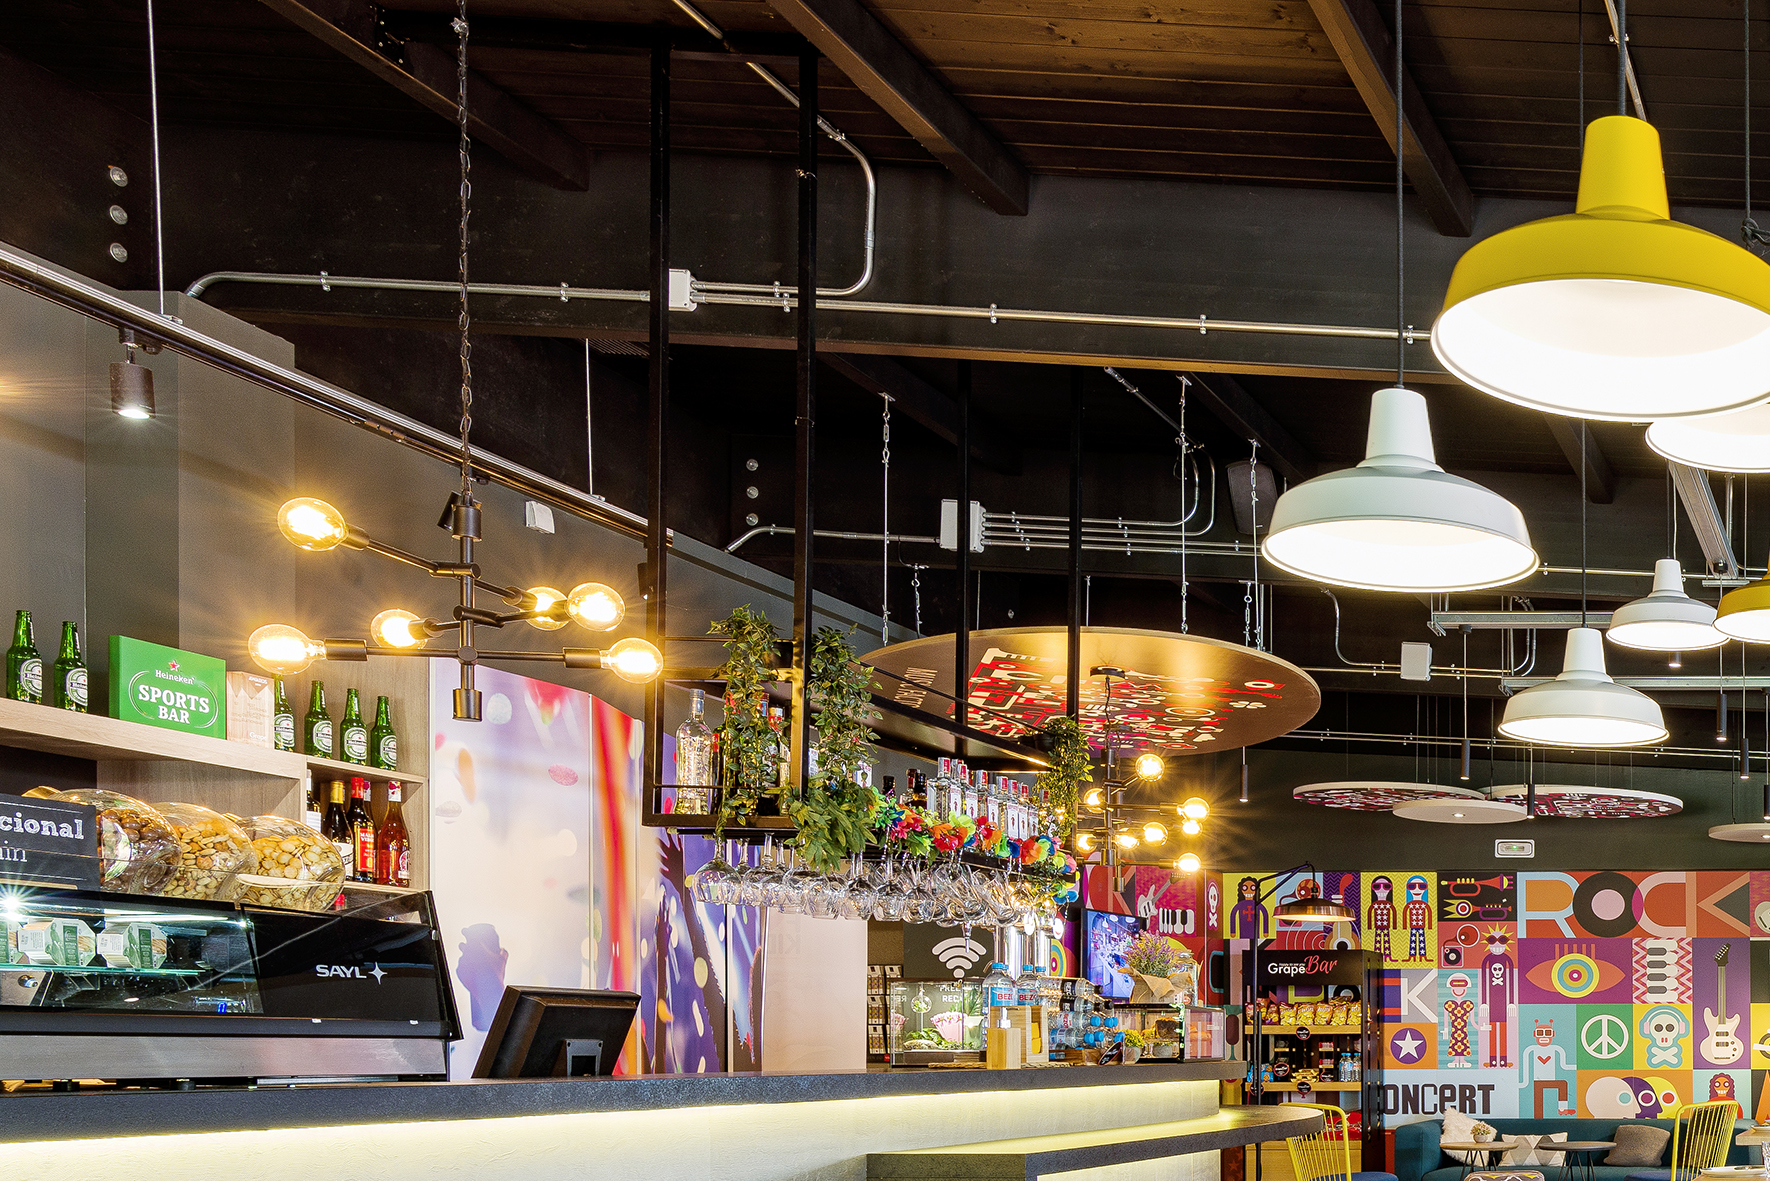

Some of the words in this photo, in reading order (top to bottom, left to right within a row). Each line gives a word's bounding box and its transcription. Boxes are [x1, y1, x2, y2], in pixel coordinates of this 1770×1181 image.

[155, 669, 195, 685] Heineken
[138, 684, 210, 713] SPORTS
[158, 705, 190, 724] BAR
[0, 812, 84, 840] cional
[1517, 871, 1750, 938] ROCK
[315, 964, 367, 979] SAYL
[1267, 962, 1306, 977] Grape
[1304, 955, 1338, 974] Bar
